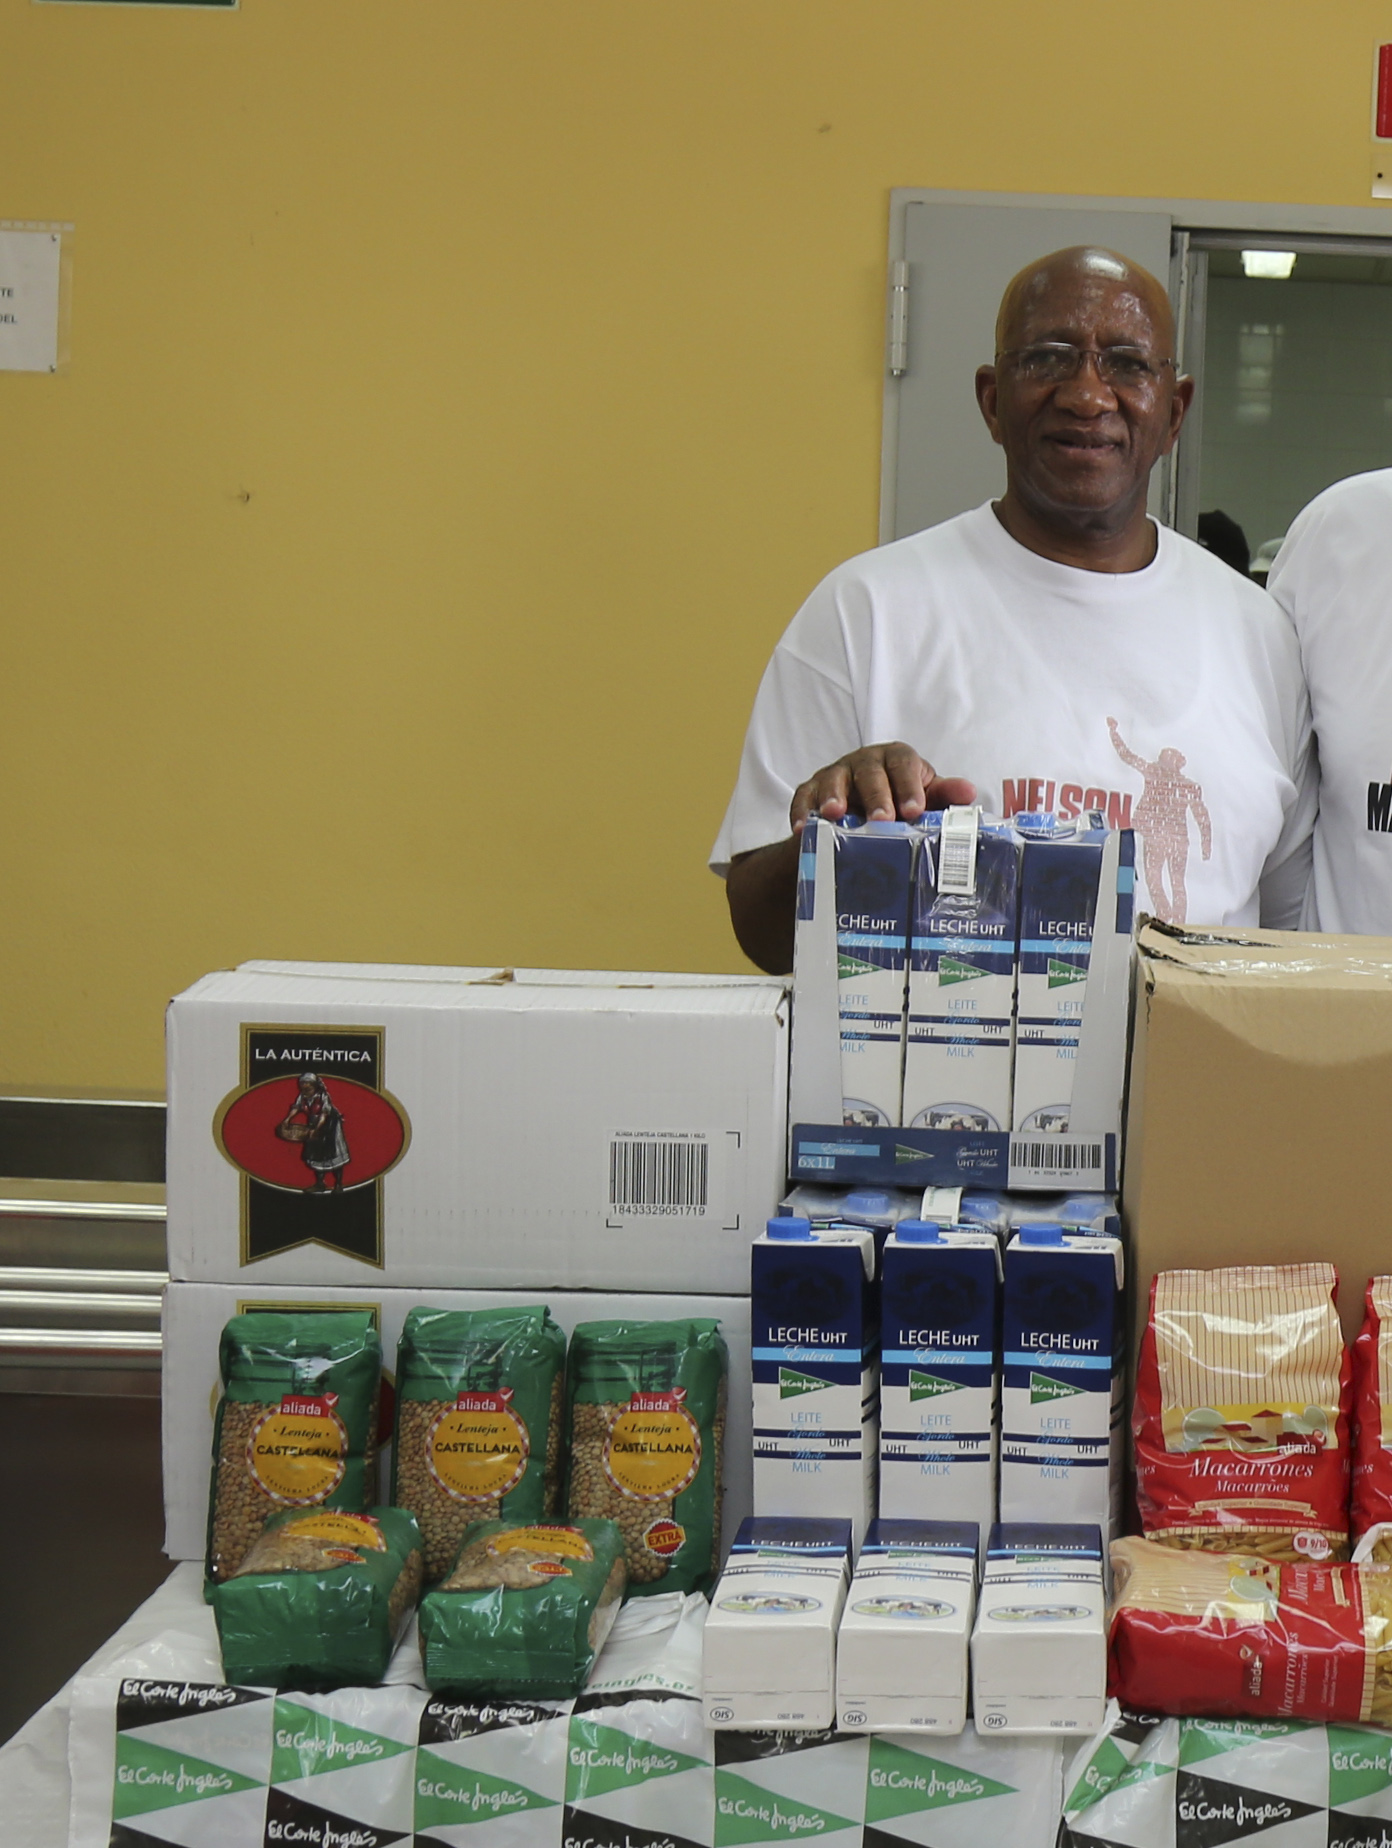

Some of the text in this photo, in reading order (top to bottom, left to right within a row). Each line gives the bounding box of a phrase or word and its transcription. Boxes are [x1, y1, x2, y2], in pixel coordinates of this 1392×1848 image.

[1002, 777, 1132, 829] NELSON
[835, 914, 897, 931] ECHE UHT
[930, 919, 1005, 936] LECHE UHT
[1039, 921, 1086, 936] LECHE
[948, 1000, 977, 1011] LEITE
[873, 1020, 895, 1030] UHT
[983, 1024, 1003, 1035] UHT
[915, 1026, 935, 1037] UHT
[1024, 1029, 1045, 1039] UHT
[256, 1047, 371, 1062] LA AUTÉNTICA
[947, 1047, 974, 1058] MILK
[798, 1156, 835, 1169] 6x1L
[768, 1327, 848, 1344] LECHE UHT
[899, 1330, 980, 1346] LECHE UHT
[1020, 1332, 1099, 1350] LECHE UHT
[782, 1344, 835, 1363] Entera
[913, 1346, 966, 1365] Entera
[1035, 1350, 1086, 1368] Entera
[282, 1402, 321, 1416] aliada
[458, 1398, 497, 1411] aliada
[632, 1399, 670, 1411] aliada
[790, 1412, 822, 1424] LEITE
[920, 1414, 952, 1426] LEITE
[1040, 1418, 1071, 1429] LEITE
[280, 1426, 322, 1439] Lenteja
[456, 1423, 500, 1435] Lenteja
[630, 1424, 673, 1434] Lenteja
[434, 1442, 521, 1454] CASTELLANA
[613, 1443, 693, 1454] CASTELLANA
[758, 1442, 779, 1452] UHT
[829, 1438, 851, 1448] UHT
[886, 1444, 908, 1454] UHT
[958, 1440, 980, 1450] UHT
[1007, 1446, 1027, 1456] UHT
[1077, 1445, 1099, 1455] UHT
[792, 1462, 822, 1473] MILK
[920, 1464, 950, 1476] MILK
[1040, 1467, 1069, 1479] MILK
[1189, 1457, 1314, 1477] Macarrones
[1215, 1479, 1290, 1493] Macarrões
[648, 1531, 682, 1546] EXTRA
[1310, 1538, 1327, 1549] 9/10
[714, 1709, 730, 1720] SIG
[846, 1713, 863, 1724] SIG
[987, 1716, 1004, 1727] SIG
